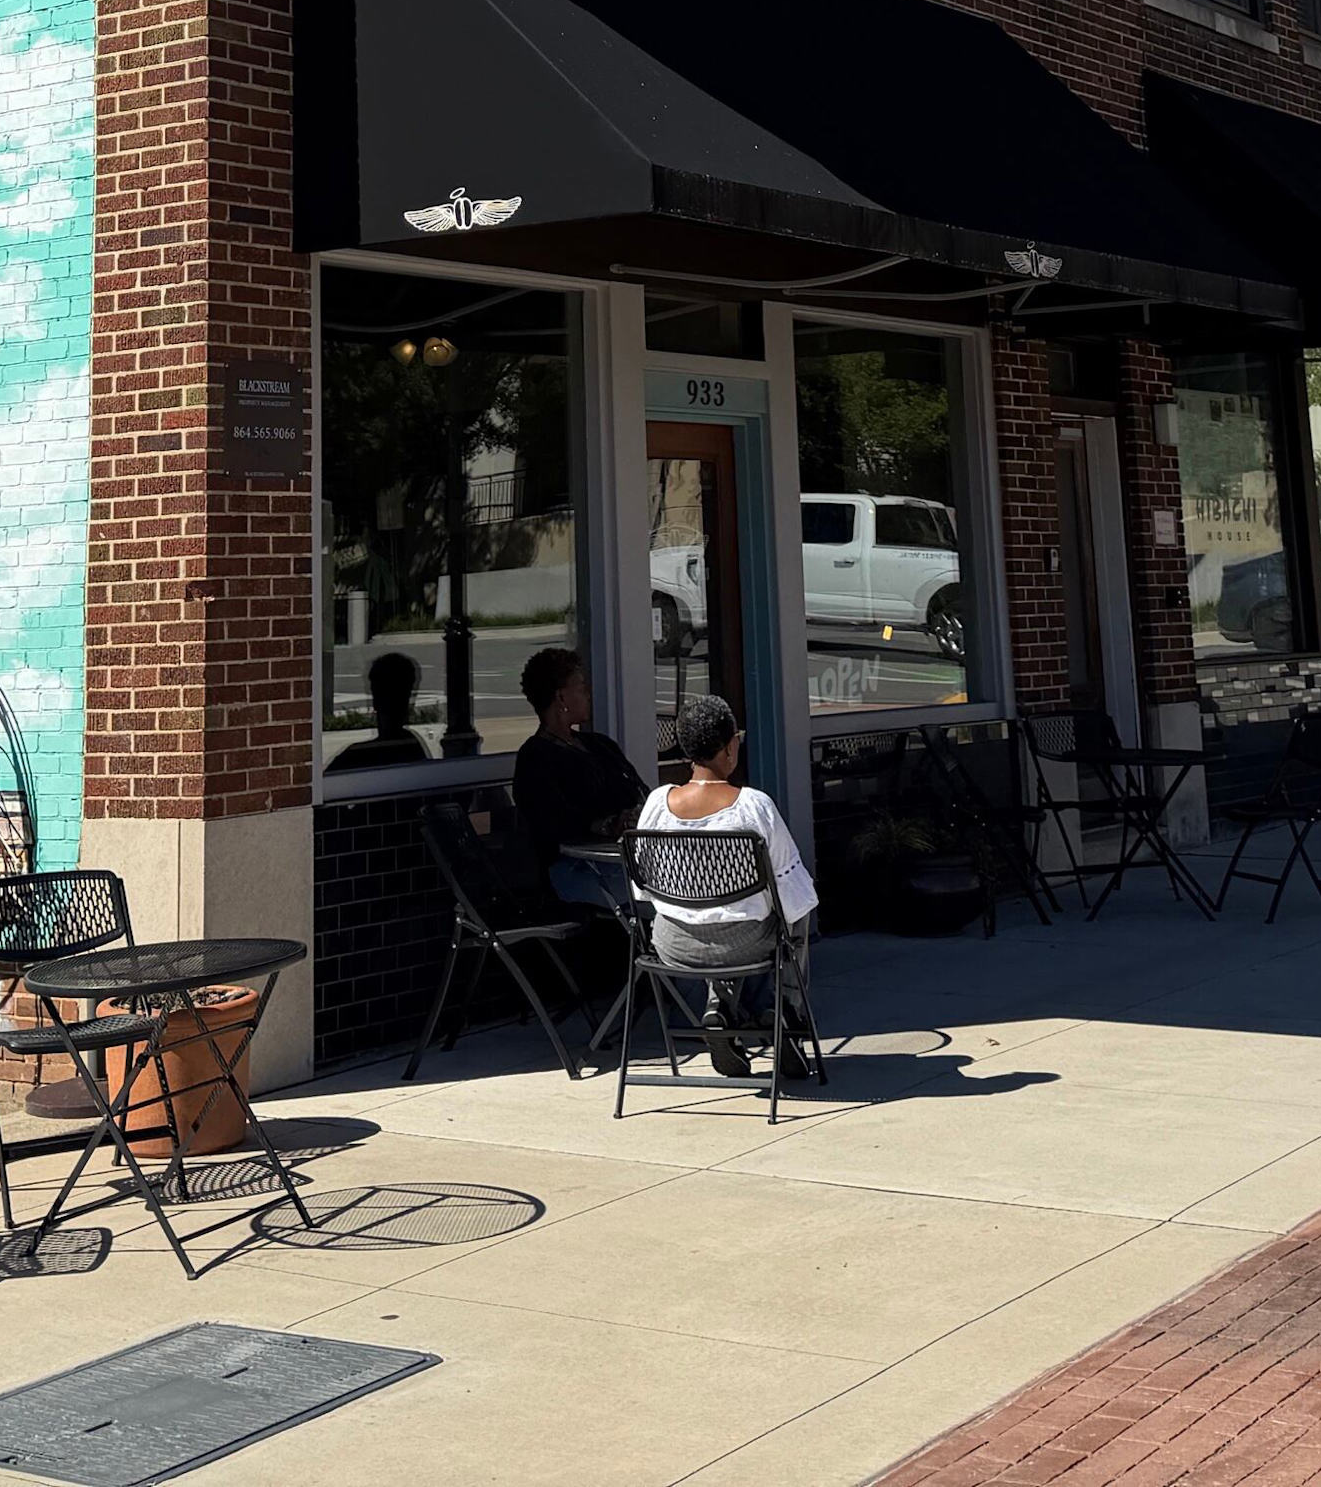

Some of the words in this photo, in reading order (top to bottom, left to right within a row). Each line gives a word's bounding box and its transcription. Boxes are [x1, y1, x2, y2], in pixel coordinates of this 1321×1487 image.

[238, 379, 290, 394] BLACKSTREAM
[687, 379, 724, 407] 933
[233, 426, 296, 440] 864.565.9066
[1196, 497, 1257, 524] HIBACHI
[1207, 531, 1251, 541] HOUSE
[821, 654, 881, 708] OPEN
